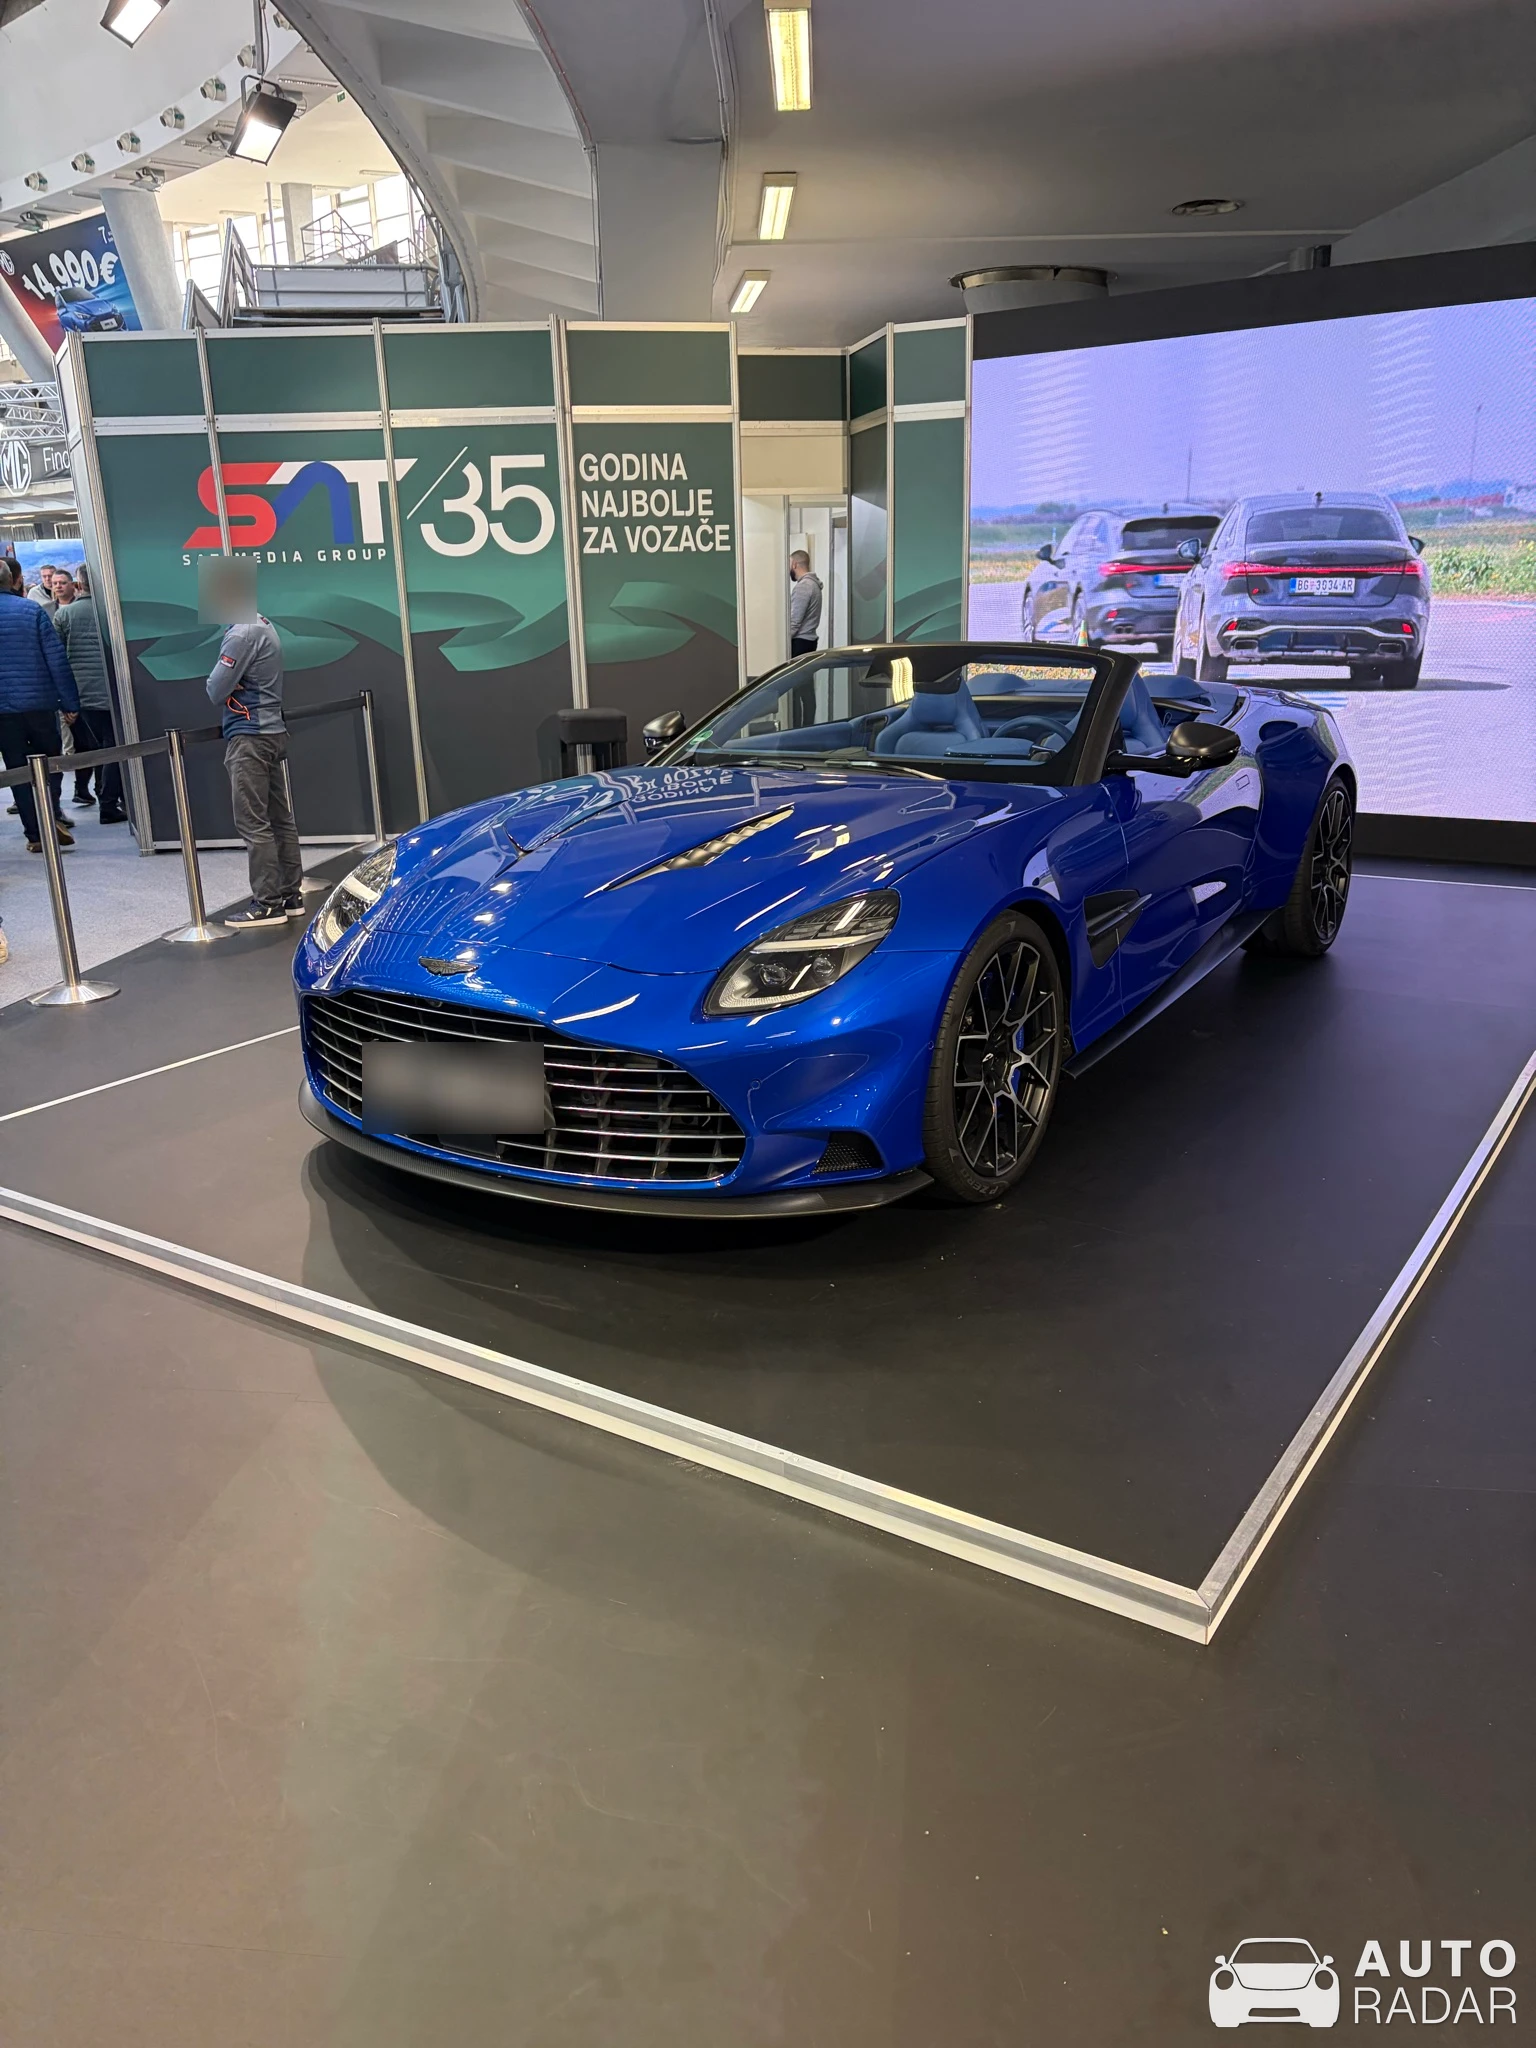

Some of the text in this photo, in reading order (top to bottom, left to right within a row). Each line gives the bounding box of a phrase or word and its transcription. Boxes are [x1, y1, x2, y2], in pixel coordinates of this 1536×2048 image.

[579, 453, 688, 482] GODINA
[581, 488, 714, 518] NAJBOLJE
[583, 518, 731, 554] ZA VOZAČE
[317, 548, 387, 562] GROUP
